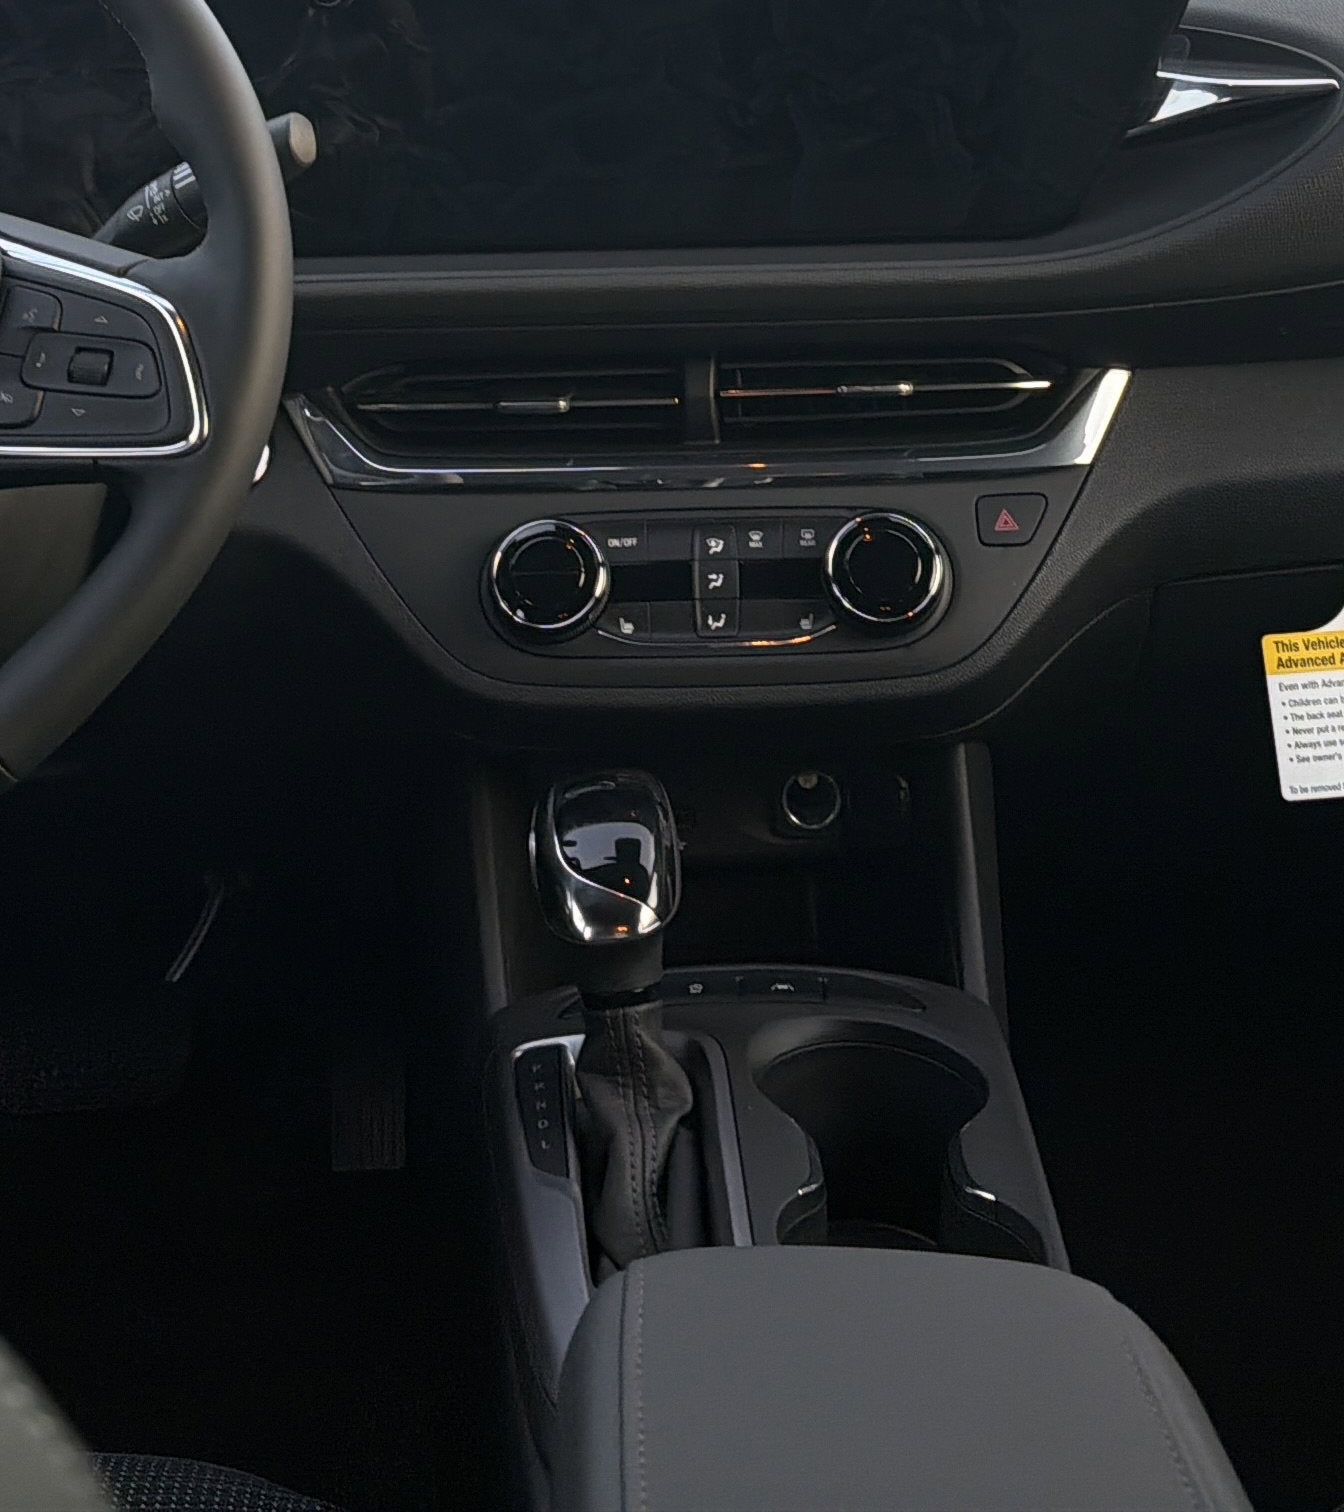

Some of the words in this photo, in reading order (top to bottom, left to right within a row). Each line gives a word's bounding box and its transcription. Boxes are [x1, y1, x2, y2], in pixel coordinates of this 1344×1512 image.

[607, 538, 638, 548] ON/OFF
[1273, 640, 1299, 654] This
[1277, 653, 1336, 670] Advanced
[1278, 682, 1299, 691] Even
[1301, 681, 1319, 689] with
[1288, 697, 1322, 708] Children
[1290, 712, 1304, 722] The
[1306, 711, 1325, 720] back
[1292, 727, 1314, 735] Never
[1316, 725, 1329, 734] put
[1294, 740, 1322, 750] Always
[1296, 755, 1310, 763] See
[1300, 785, 1309, 794] be
[1311, 782, 1341, 792] removed
